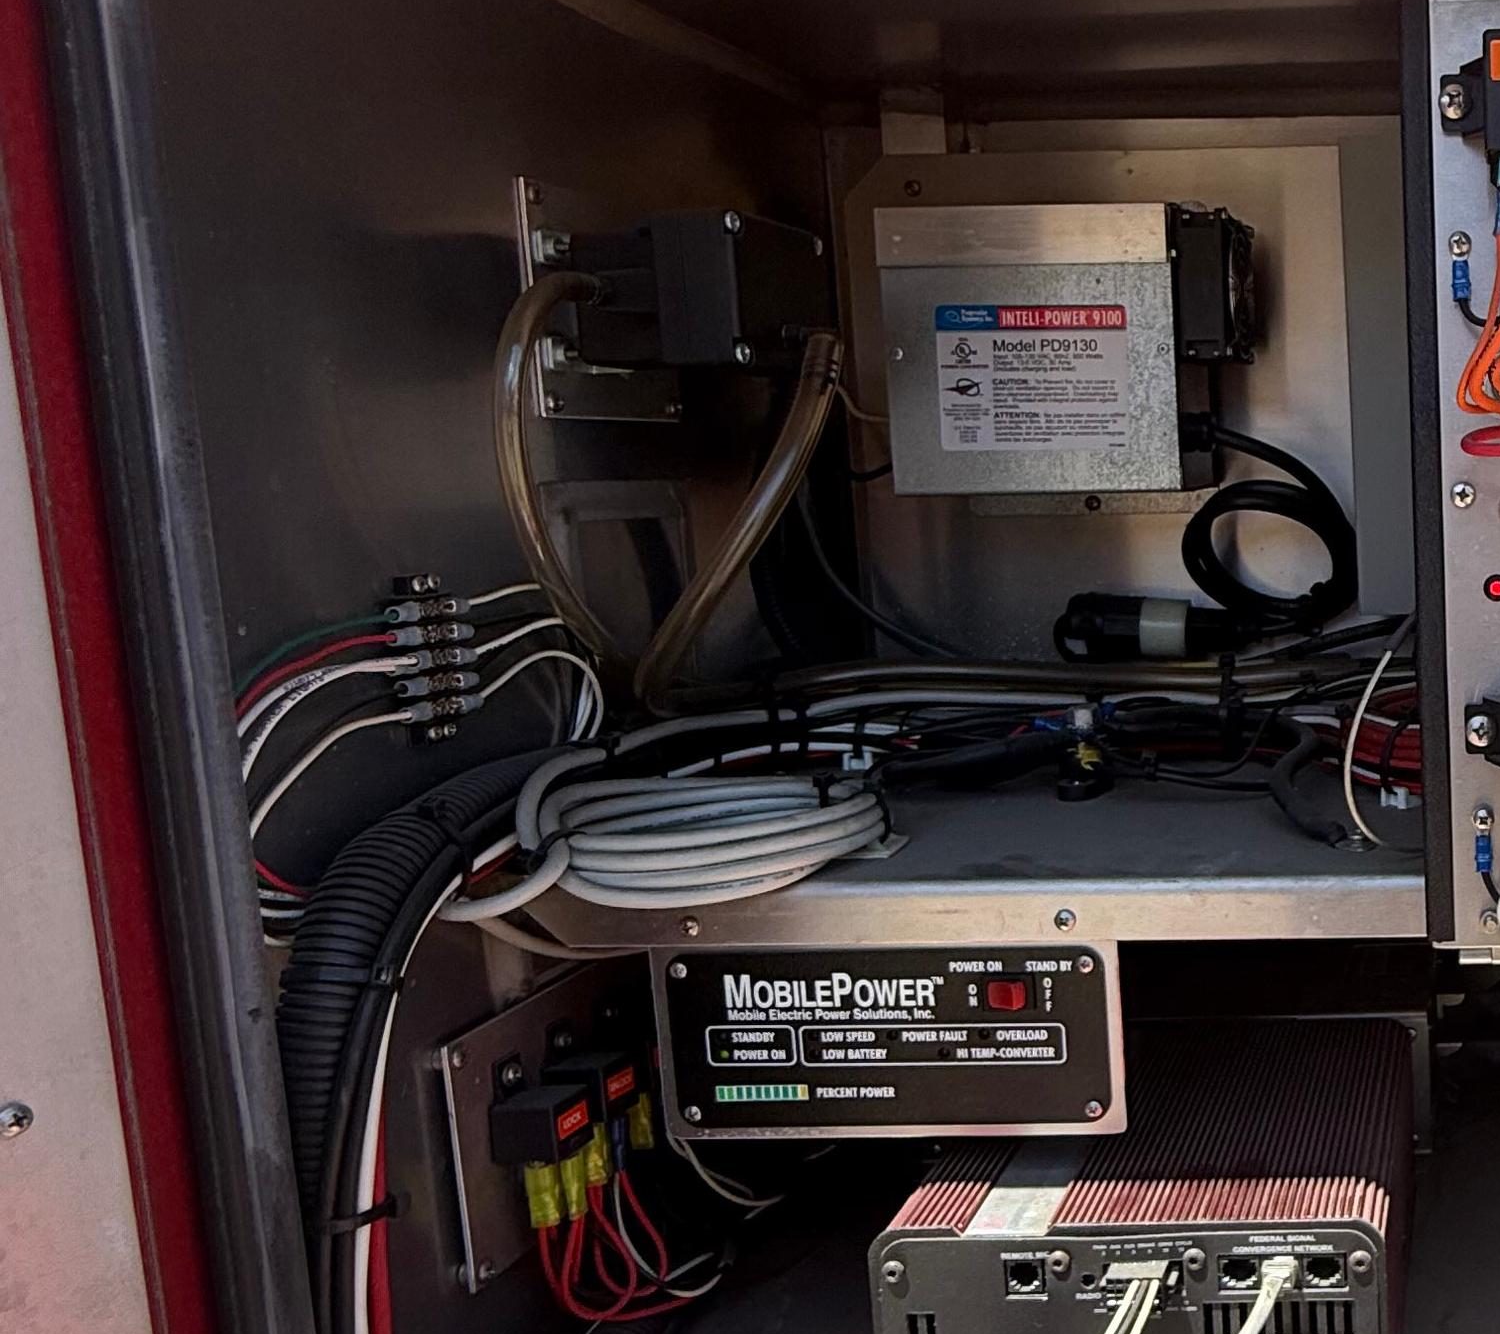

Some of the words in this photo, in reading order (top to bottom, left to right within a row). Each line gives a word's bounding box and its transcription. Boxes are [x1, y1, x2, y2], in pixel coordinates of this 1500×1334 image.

[1093, 310, 1122, 326] 9100
[992, 339, 1036, 353] Model
[1040, 339, 1098, 352] PD9130
[949, 962, 985, 973] POWER
[986, 962, 1003, 972] ON
[1025, 961, 1058, 972] STAND
[1060, 961, 1073, 971] BY
[727, 1009, 767, 1021] Mobile
[769, 1009, 812, 1021] Electric
[815, 1009, 851, 1020] Power
[853, 1008, 912, 1021] Solutions,
[914, 1008, 936, 1020] Inc.
[731, 1032, 776, 1043] STANDBY
[820, 1031, 844, 1042] LOW
[846, 1031, 876, 1042] SPEED
[902, 1031, 938, 1042] POWER
[939, 1030, 968, 1042] FAULT
[996, 1030, 1049, 1041] OVERLOAD
[733, 1050, 770, 1061] POWER
[771, 1049, 787, 1060] ON
[822, 1049, 846, 1060] LOW
[847, 1049, 888, 1059] BATTERY
[956, 1047, 969, 1059] HI
[971, 1047, 1056, 1059] TEMP-CONVERTER
[816, 1087, 858, 1098] PERCENT
[860, 1087, 896, 1098] POWER
[562, 1112, 583, 1130] LOCK
